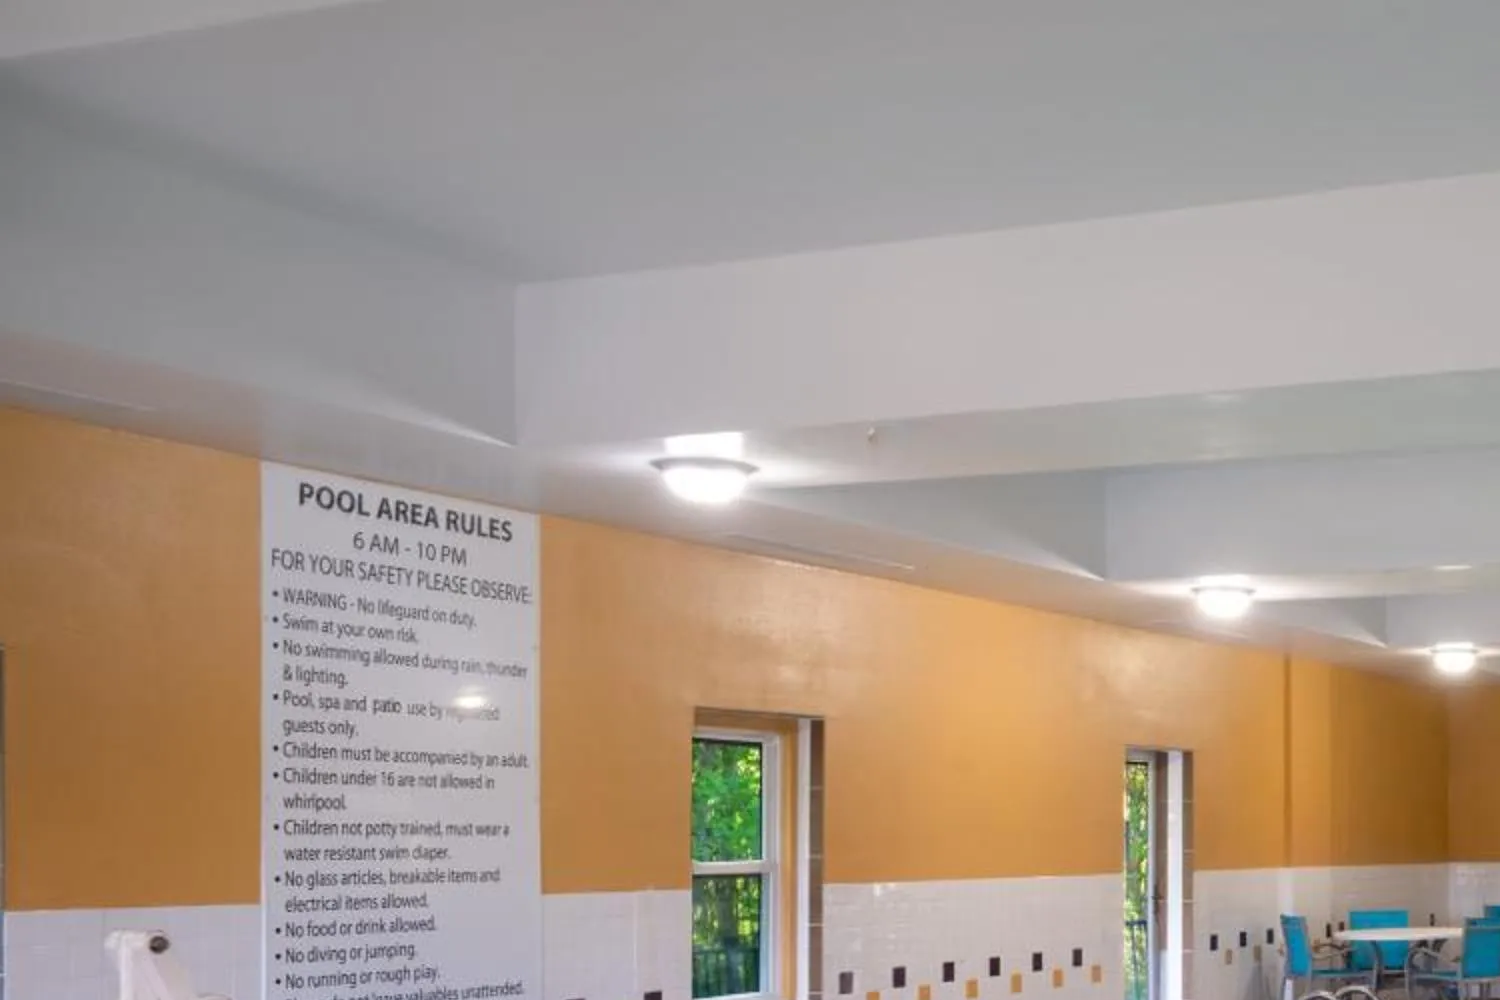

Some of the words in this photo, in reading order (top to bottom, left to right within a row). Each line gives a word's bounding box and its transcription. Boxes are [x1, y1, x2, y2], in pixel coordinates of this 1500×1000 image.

[299, 482, 371, 518] POOL
[376, 497, 439, 529] AREA
[446, 509, 513, 542] RULES
[353, 531, 365, 551] 6
[369, 533, 399, 557] AM
[417, 541, 436, 561] 10
[441, 545, 467, 567] PM
[271, 548, 305, 572] FOR
[309, 553, 355, 578] YOUR
[357, 561, 413, 587] SAFETY
[417, 570, 468, 595] PLEASE
[282, 587, 348, 611] WARNING
[357, 597, 375, 614] No
[378, 598, 429, 621] lifeguard
[431, 609, 447, 622] on
[449, 609, 478, 630] duty.
[282, 611, 319, 633] Swim
[321, 621, 334, 634] at
[336, 622, 366, 639] your
[367, 626, 394, 640] own
[282, 639, 302, 656] No
[304, 643, 371, 667] swimming
[372, 647, 419, 667] allowed
[421, 655, 459, 675] during
[295, 664, 349, 689] lighting.
[282, 689, 315, 709] Pool,
[318, 697, 341, 712] spa
[343, 695, 367, 712] and
[371, 697, 402, 715] patio
[406, 703, 427, 717] use
[429, 702, 442, 721] by
[282, 719, 325, 737] guests
[326, 719, 359, 739] only.
[282, 741, 338, 760] Children
[340, 747, 371, 761] must
[374, 747, 391, 763] be
[392, 751, 469, 767] accompanied
[470, 751, 485, 769] by
[486, 754, 500, 767] an
[282, 767, 338, 785] Children
[340, 769, 377, 787] under
[397, 775, 416, 788] are
[418, 775, 437, 788] not
[439, 773, 482, 789] allowed
[484, 775, 495, 789] in
[283, 819, 339, 836] Children
[341, 822, 363, 836] not
[364, 822, 398, 840] potty
[445, 823, 474, 837] must
[475, 825, 502, 837] wear
[283, 847, 321, 861] water
[323, 845, 378, 861] resistant
[379, 845, 410, 861] swim
[284, 870, 303, 887] No
[305, 869, 339, 891] glass
[388, 867, 446, 885] breakable
[447, 868, 478, 884] items
[479, 866, 501, 883] and
[284, 896, 342, 913] electrical
[343, 896, 379, 911] items
[285, 921, 304, 938] No
[306, 918, 337, 937] food
[338, 922, 353, 936] or
[354, 917, 386, 935] drink
[285, 947, 304, 964] No
[306, 945, 347, 965] diving
[349, 947, 363, 961] or
[285, 972, 304, 990] No
[306, 971, 358, 989] running
[359, 971, 373, 985] or
[375, 965, 411, 986] rough
